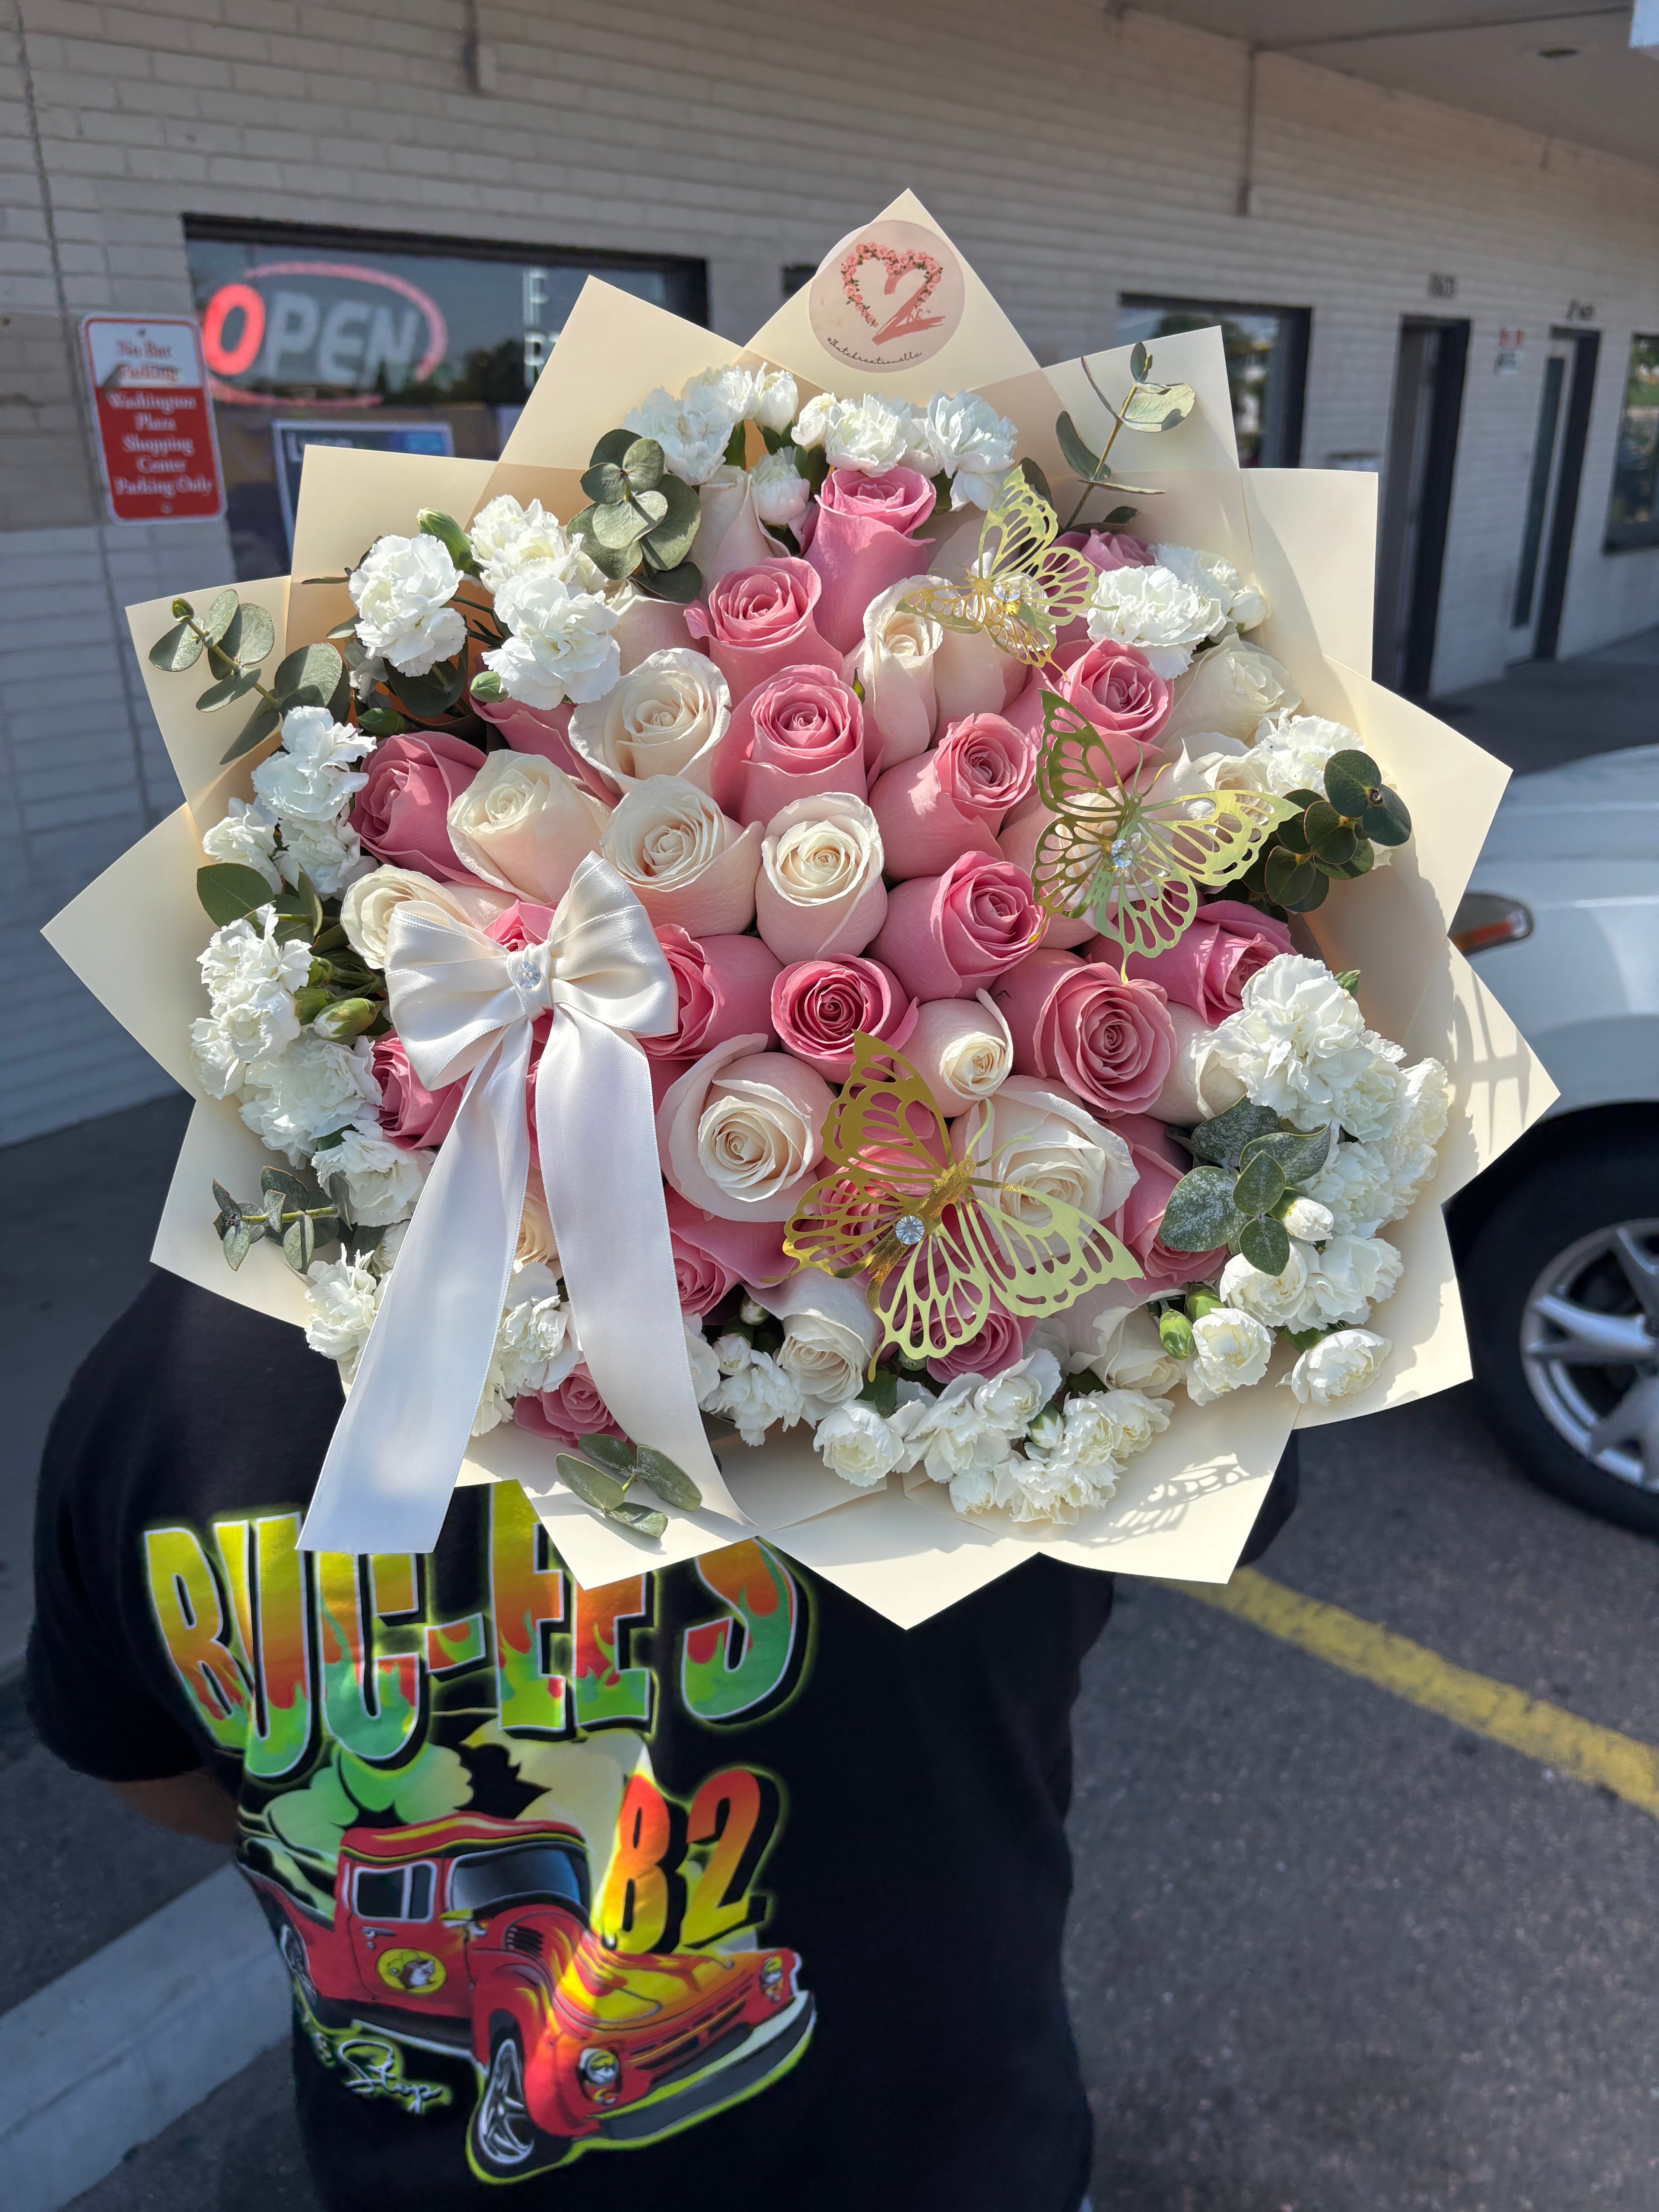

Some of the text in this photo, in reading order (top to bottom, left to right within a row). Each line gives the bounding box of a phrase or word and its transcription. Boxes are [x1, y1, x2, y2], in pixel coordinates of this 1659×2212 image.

[204, 283, 420, 393] OPEN
[108, 391, 196, 414] Washington
[135, 412, 176, 431] Plaza
[123, 434, 194, 457] Shopping
[136, 455, 186, 474] Center
[115, 474, 212, 498] Parking Only
